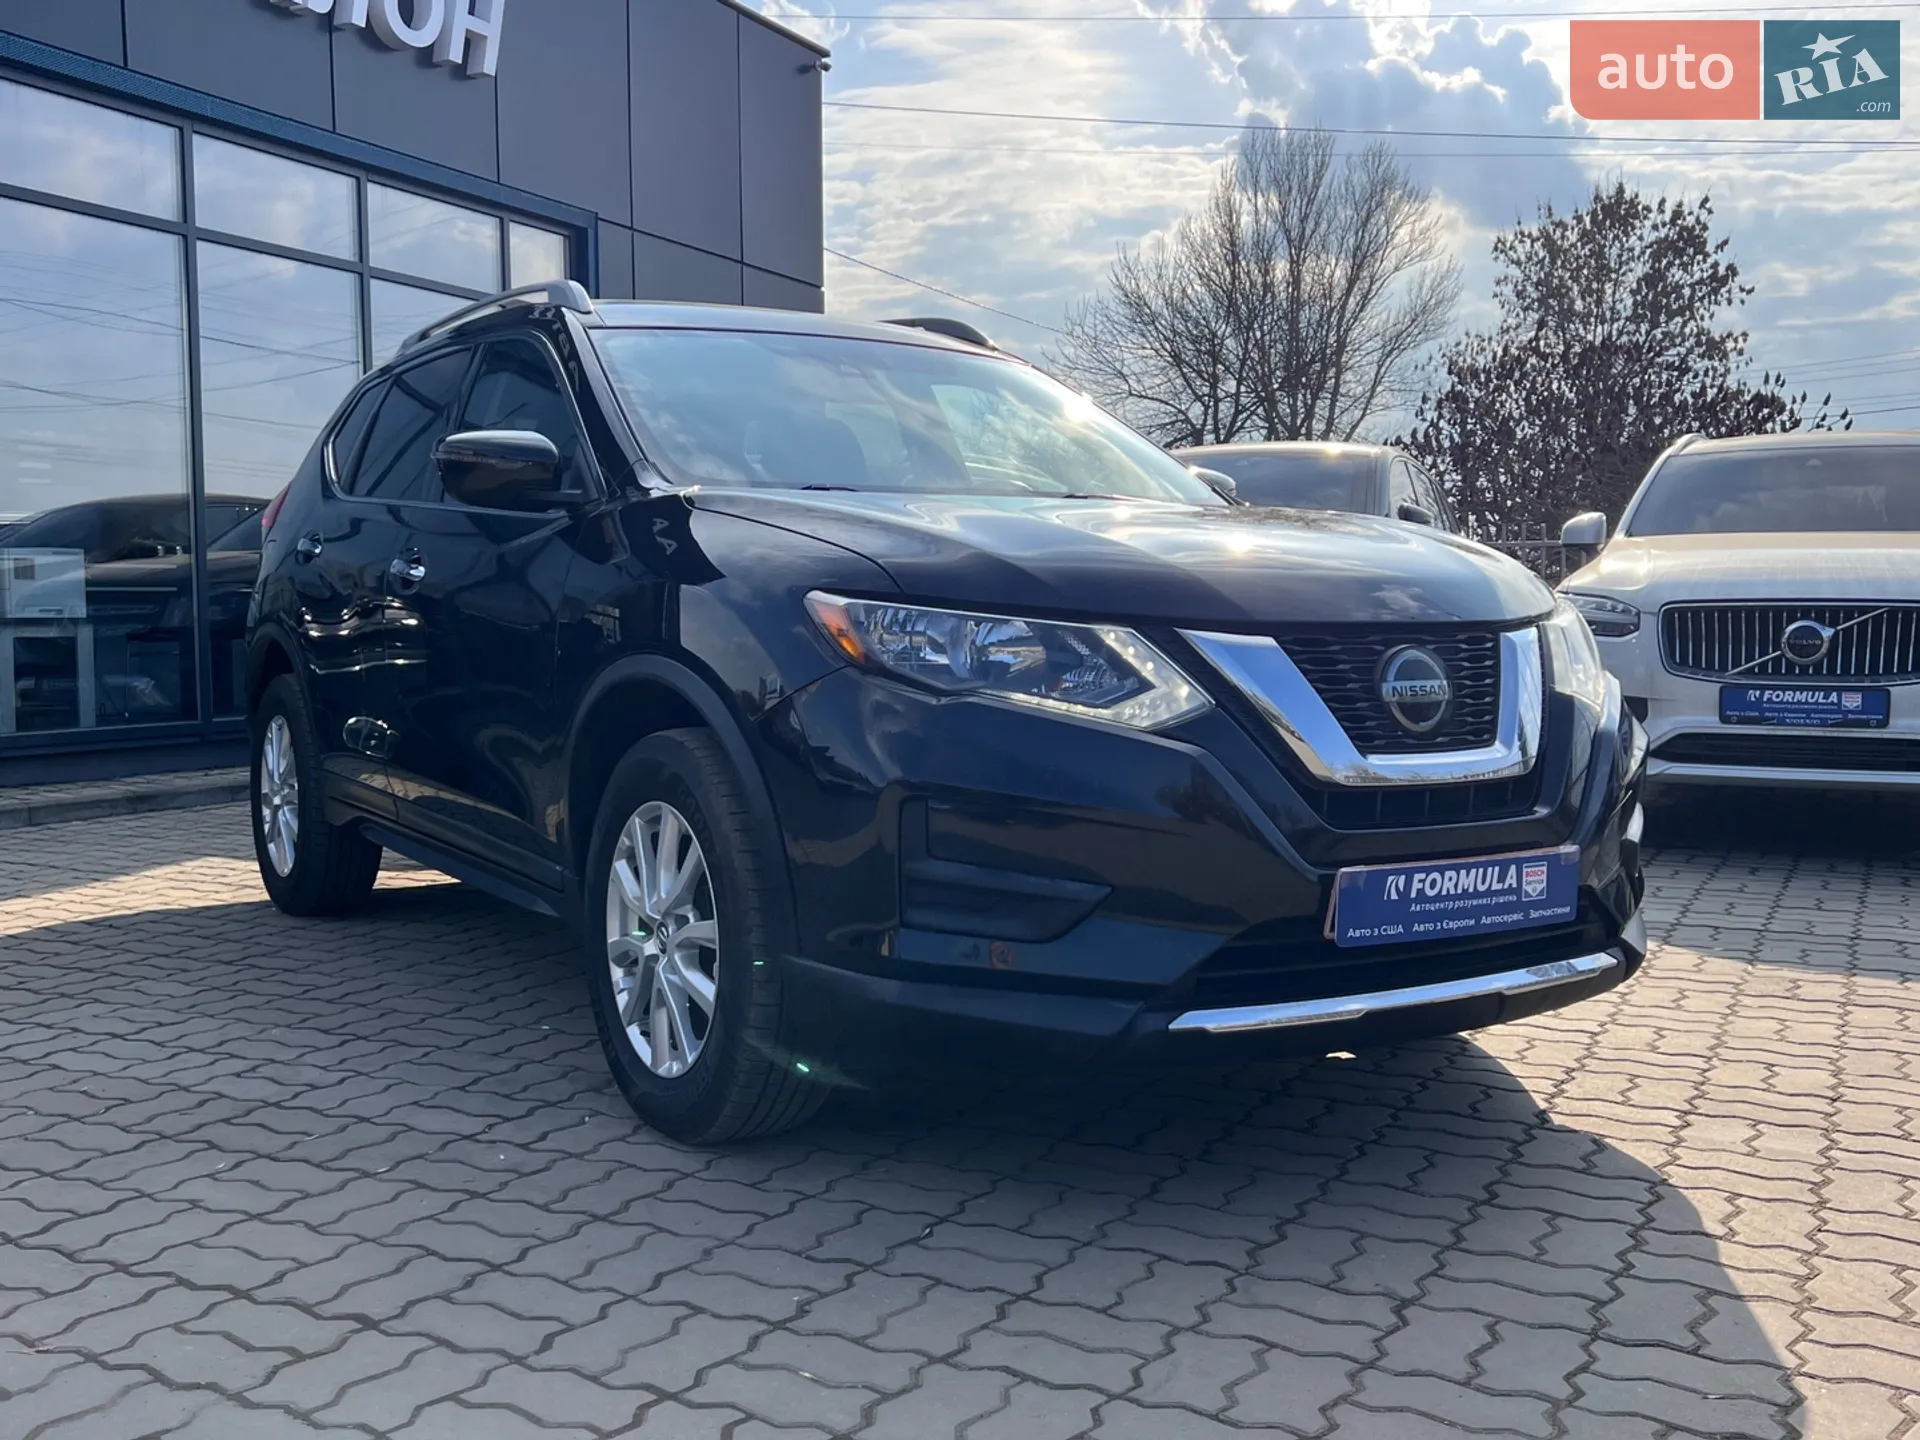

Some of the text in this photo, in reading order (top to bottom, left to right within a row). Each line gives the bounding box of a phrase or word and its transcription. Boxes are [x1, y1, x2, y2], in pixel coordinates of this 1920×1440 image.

[1391, 684, 1447, 697] NISSAN
[1763, 690, 1838, 703] FORMULA
[1525, 869, 1545, 878] BOSCH
[1410, 864, 1518, 899] FORMULA
[1409, 902, 1453, 912] Автоцентр
[1346, 928, 1372, 938] Авто
[1380, 924, 1404, 935] США
[1412, 922, 1435, 932] Авто
[1442, 919, 1476, 930] Європи
[1480, 910, 1524, 925] Автосервіс
